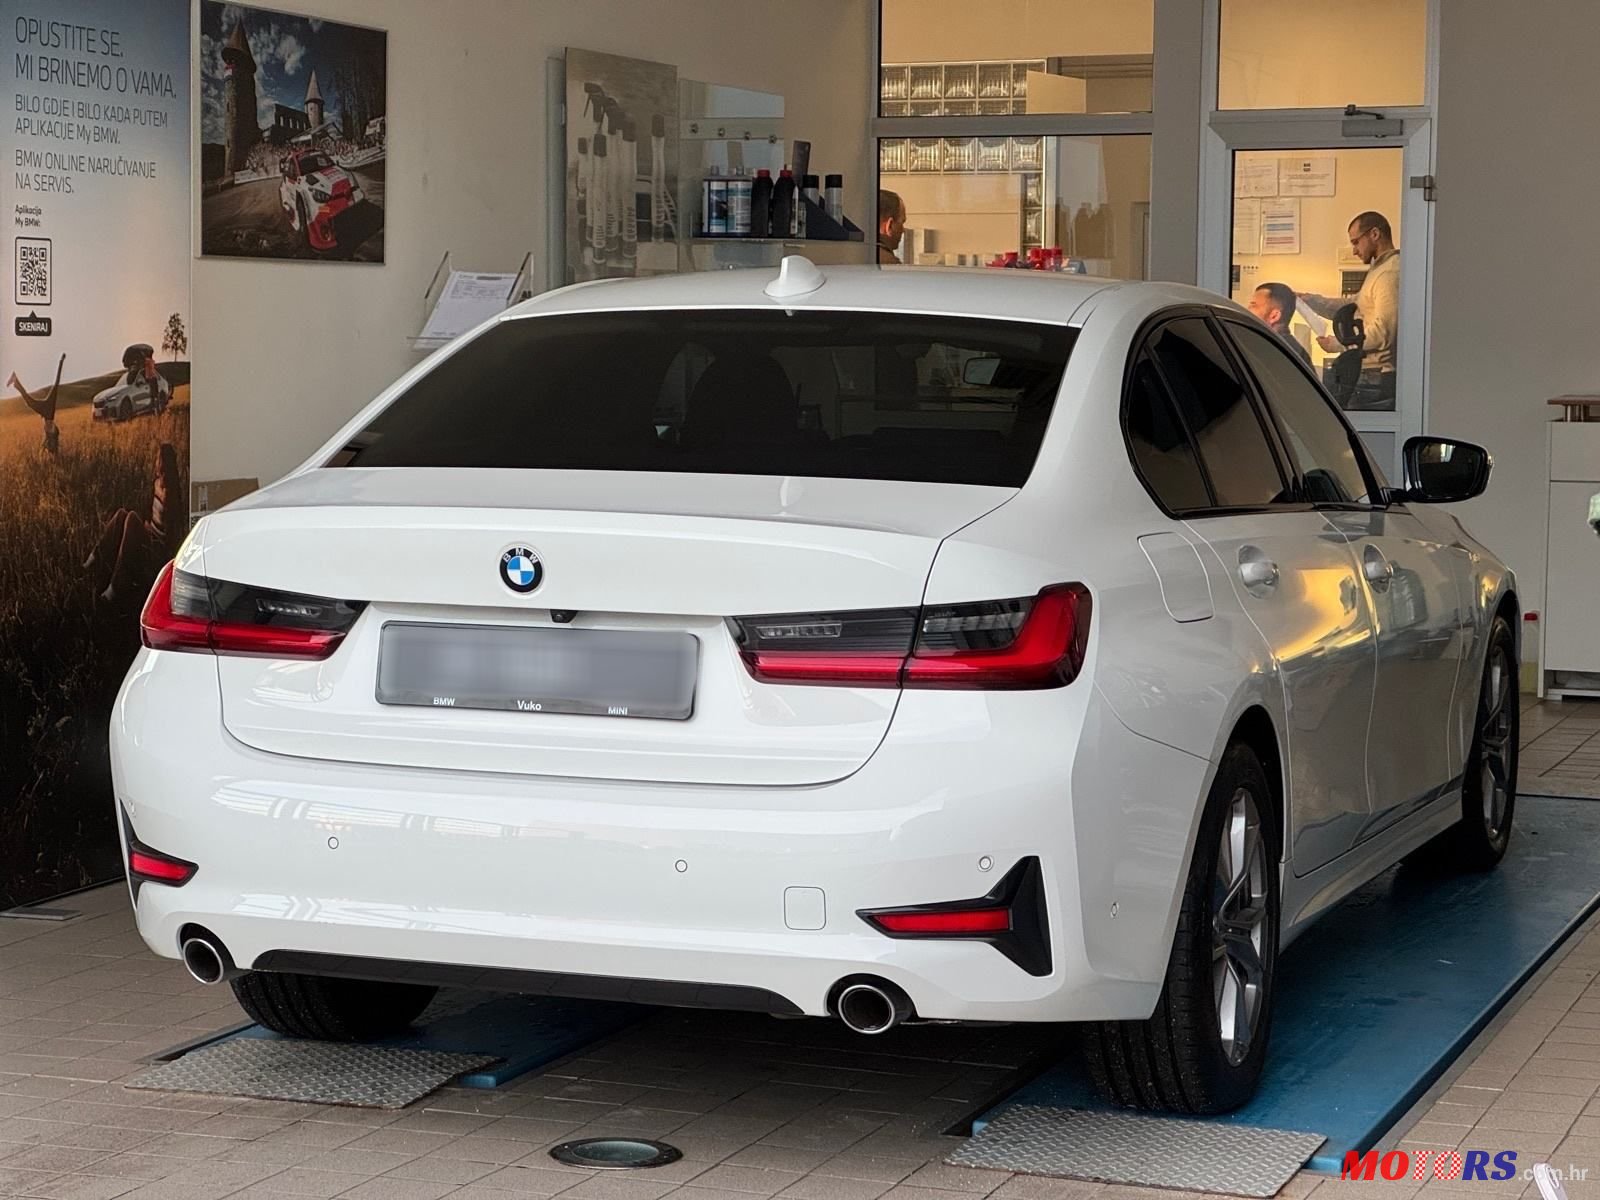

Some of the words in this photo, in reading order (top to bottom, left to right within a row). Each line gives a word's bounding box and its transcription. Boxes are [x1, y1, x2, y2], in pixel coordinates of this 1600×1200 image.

[15, 16, 97, 53] OPUSTITE
[100, 29, 124, 57] SE.
[15, 53, 33, 80] MI
[38, 56, 112, 91] BRINEMO
[116, 67, 128, 93] O
[131, 69, 177, 99] VAMA.
[15, 94, 40, 113] BILO
[43, 97, 70, 117] GDJE
[77, 101, 100, 121] BILO
[103, 105, 131, 124] KADA
[133, 108, 168, 128] PUTEM
[15, 117, 74, 140] APLIKACIJE
[76, 124, 91, 145] My
[93, 126, 121, 144] BMW.
[15, 149, 43, 168] BMW
[45, 152, 85, 173] ONLINE
[88, 156, 157, 179] NARUČIVANJE
[15, 172, 31, 190] NA
[34, 174, 75, 194] SERVIS.
[15, 203, 42, 216] Aplikacija
[18, 321, 48, 333] SKENIRAJ
[502, 547, 539, 564] BMW
[433, 697, 456, 707] BMW
[517, 700, 542, 711] Vuko
